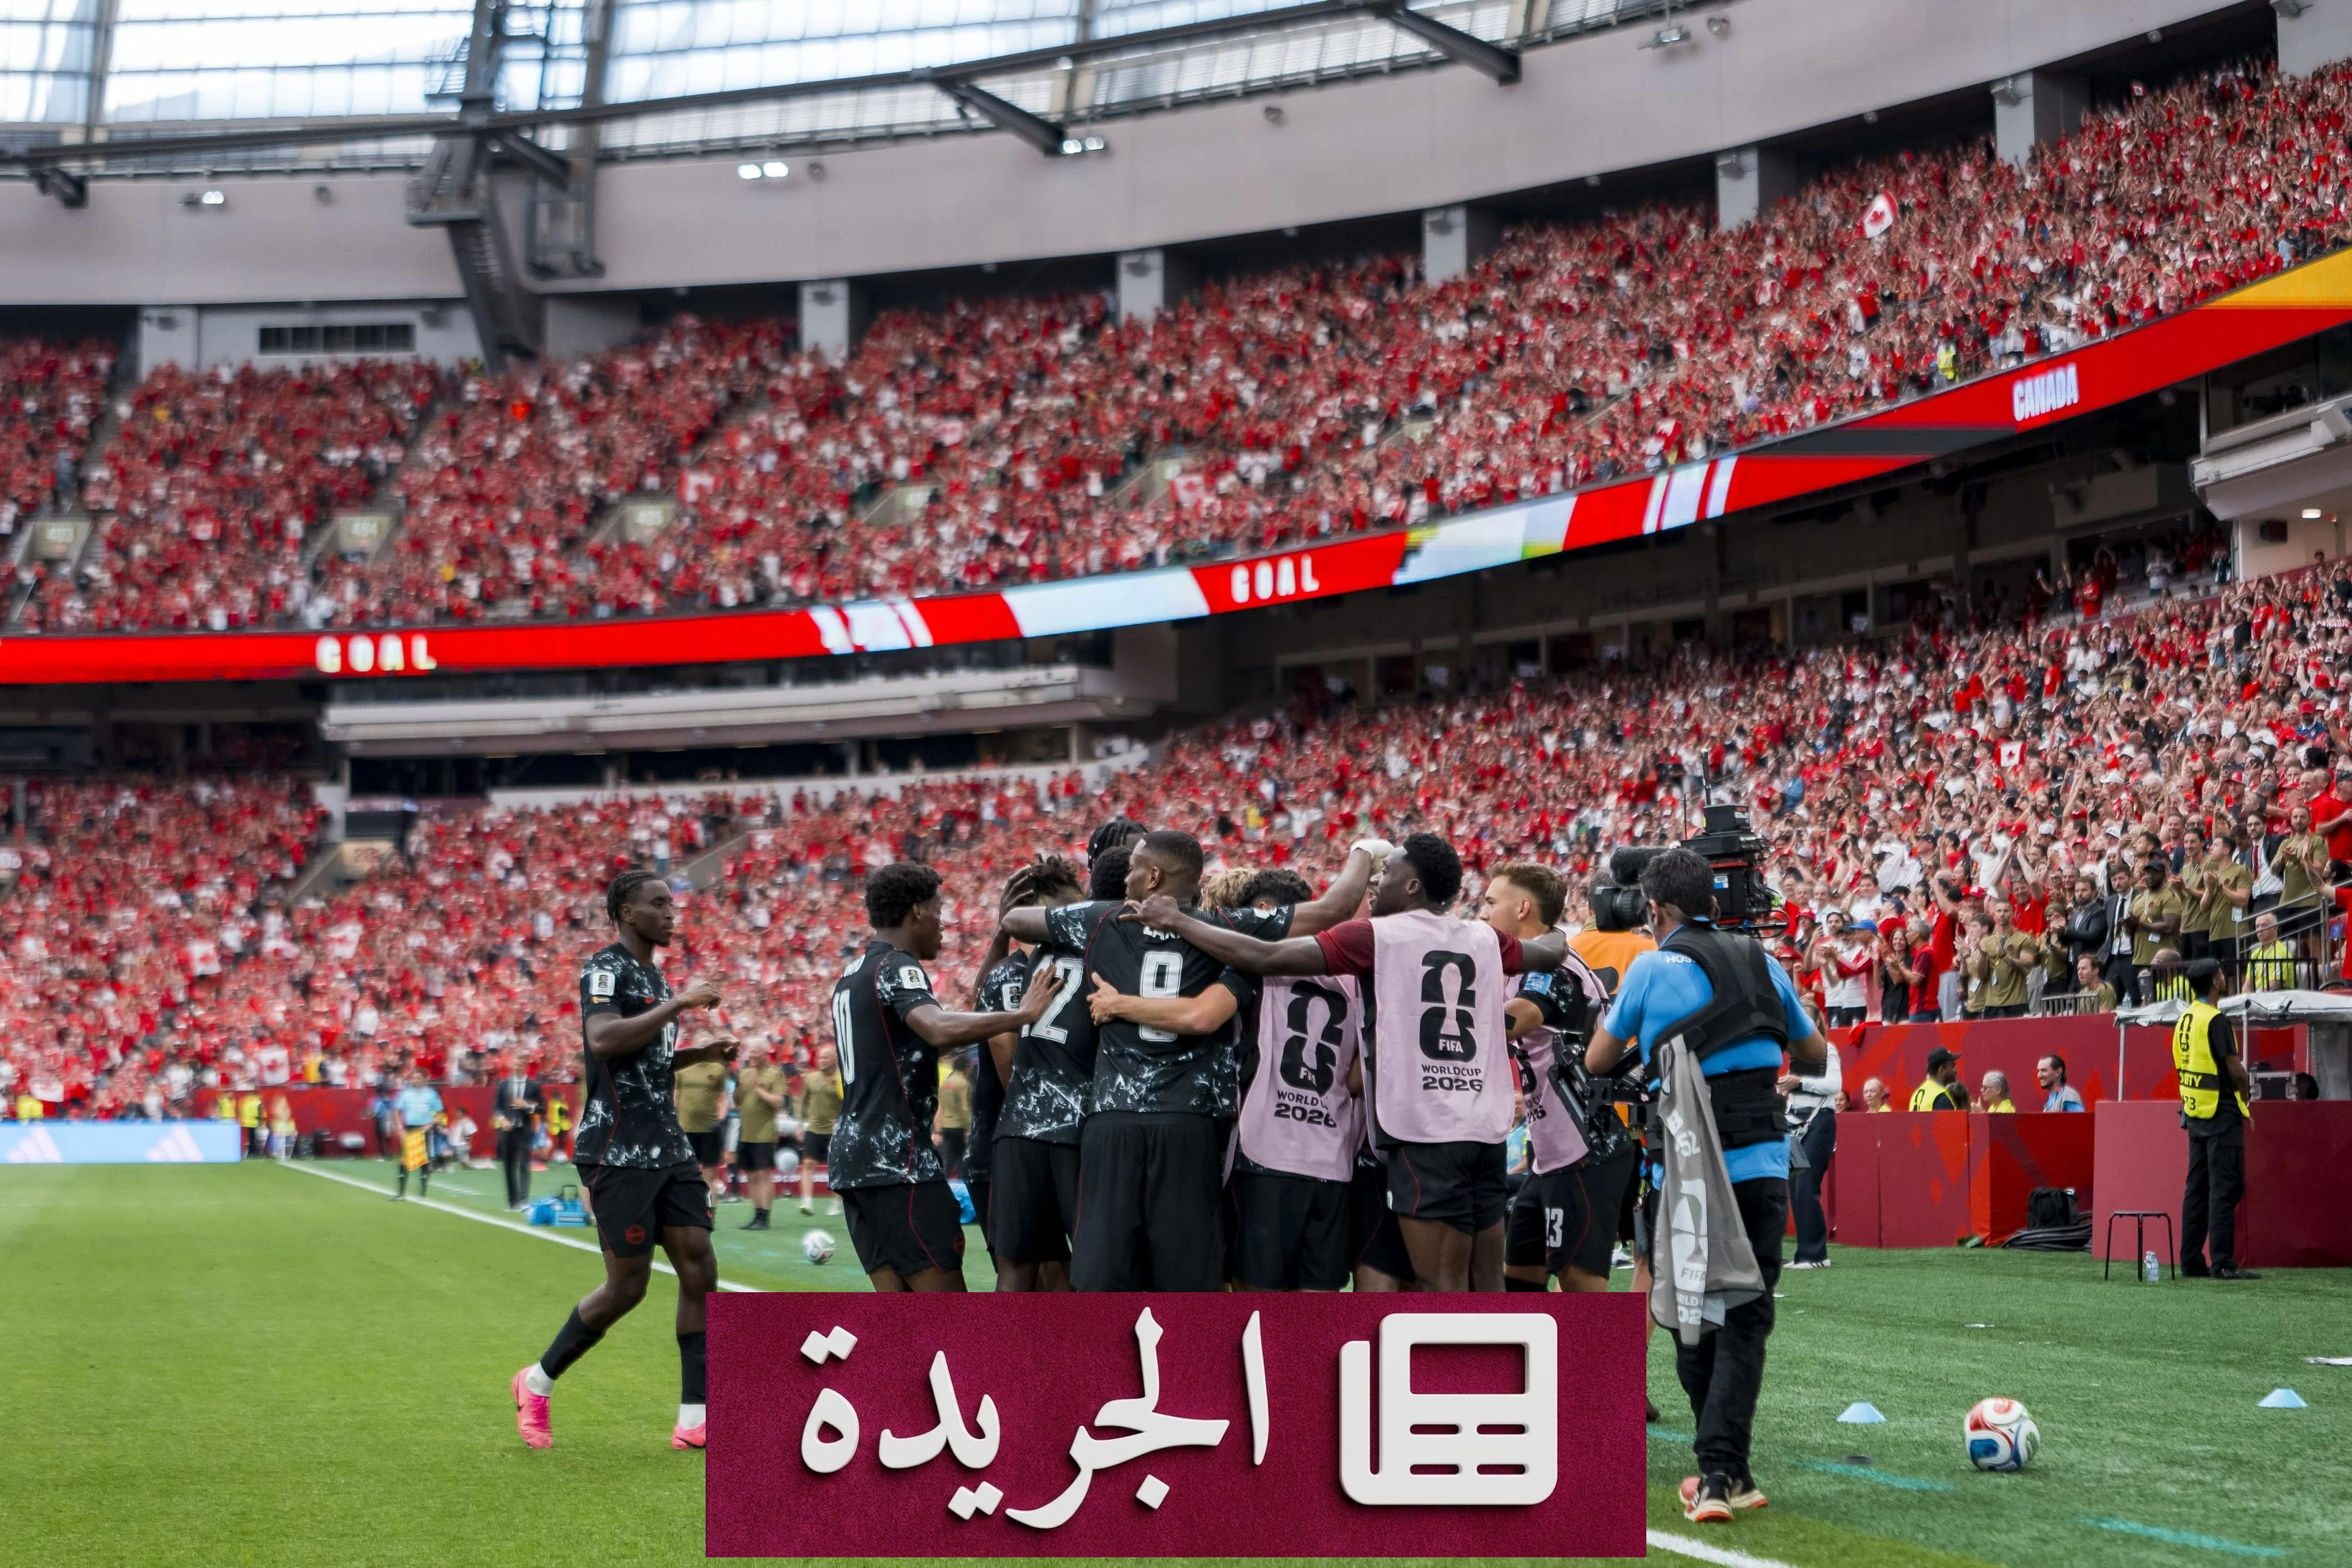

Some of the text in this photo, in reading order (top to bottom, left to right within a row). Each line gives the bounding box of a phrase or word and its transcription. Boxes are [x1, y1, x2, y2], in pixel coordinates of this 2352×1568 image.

[2012, 362, 2079, 422] CANADA
[1230, 554, 1320, 603] GOAL
[315, 634, 437, 673] GOAL
[1666, 955, 1696, 963] HOS
[832, 989, 855, 1084] 10
[1439, 1039, 1464, 1053] FIFA
[1421, 1064, 1482, 1077] WORLD CUP
[1422, 1076, 1483, 1093] 2026
[1277, 1090, 1318, 1106] WORLD
